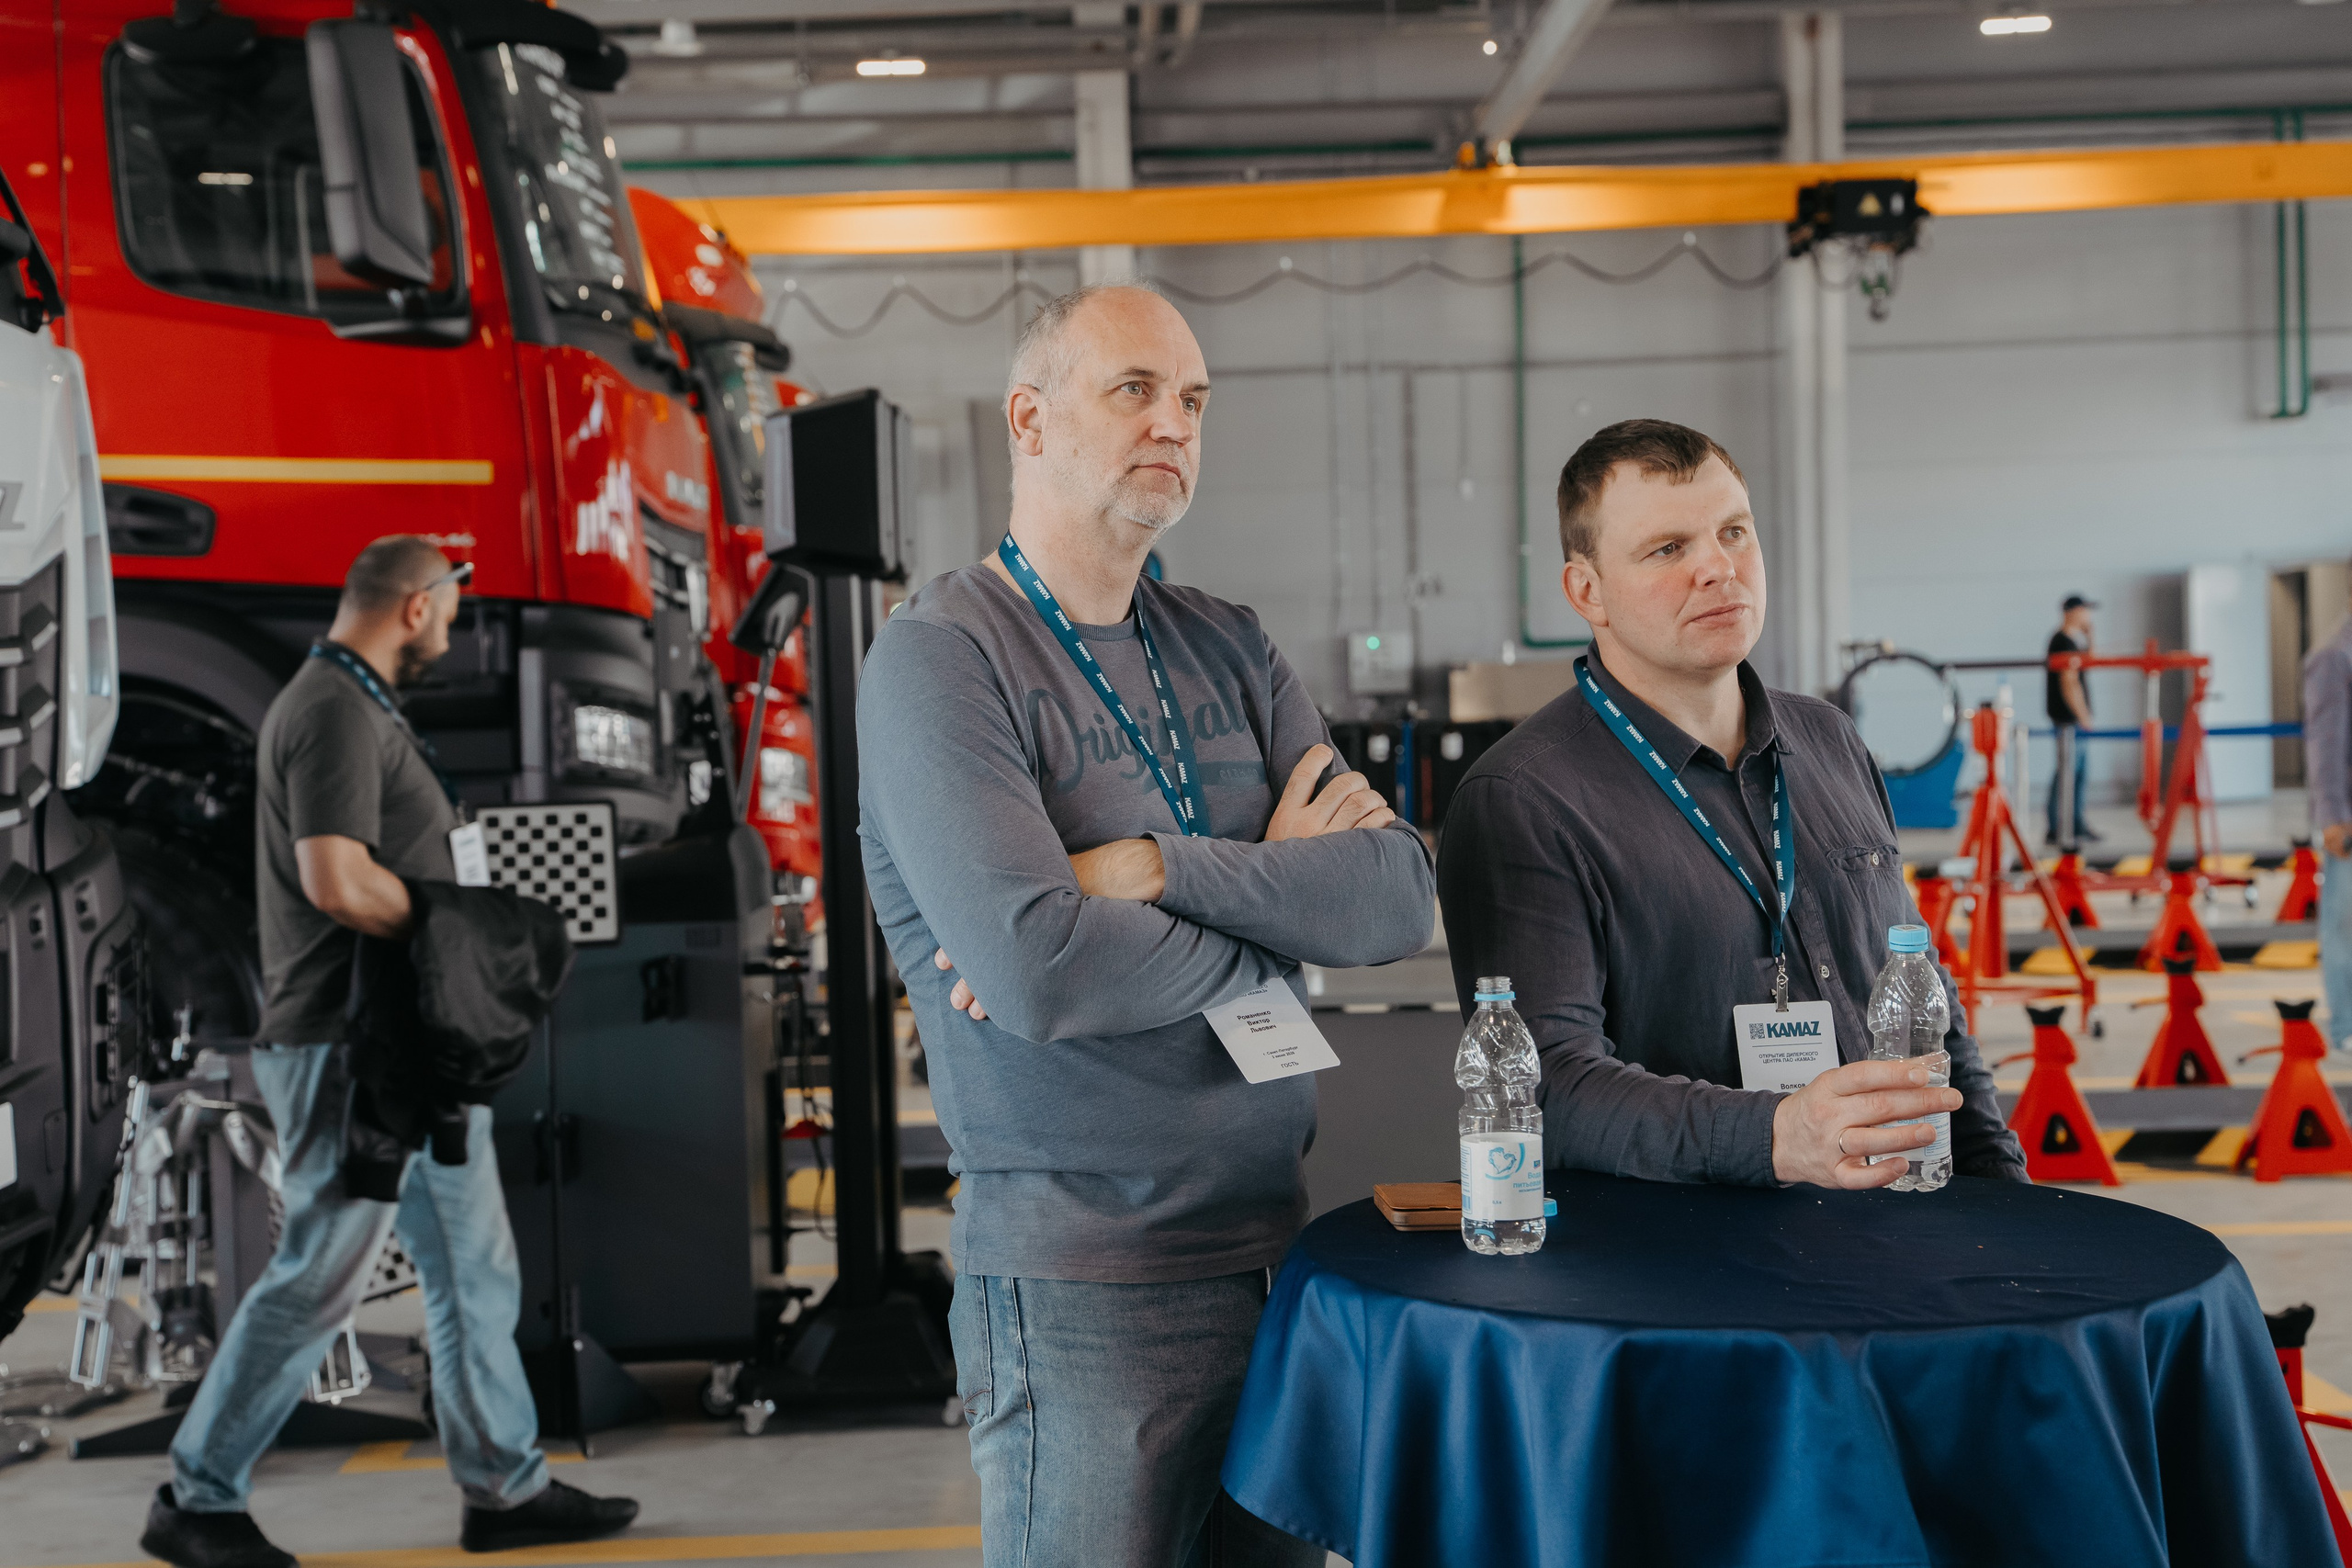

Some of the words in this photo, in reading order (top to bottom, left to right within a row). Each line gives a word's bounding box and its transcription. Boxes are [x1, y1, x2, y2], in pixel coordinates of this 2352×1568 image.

[1237, 1010, 1272, 1021] Романенко
[1250, 1024, 1277, 1032] Львович
[1766, 1021, 1822, 1039] KAMAZ
